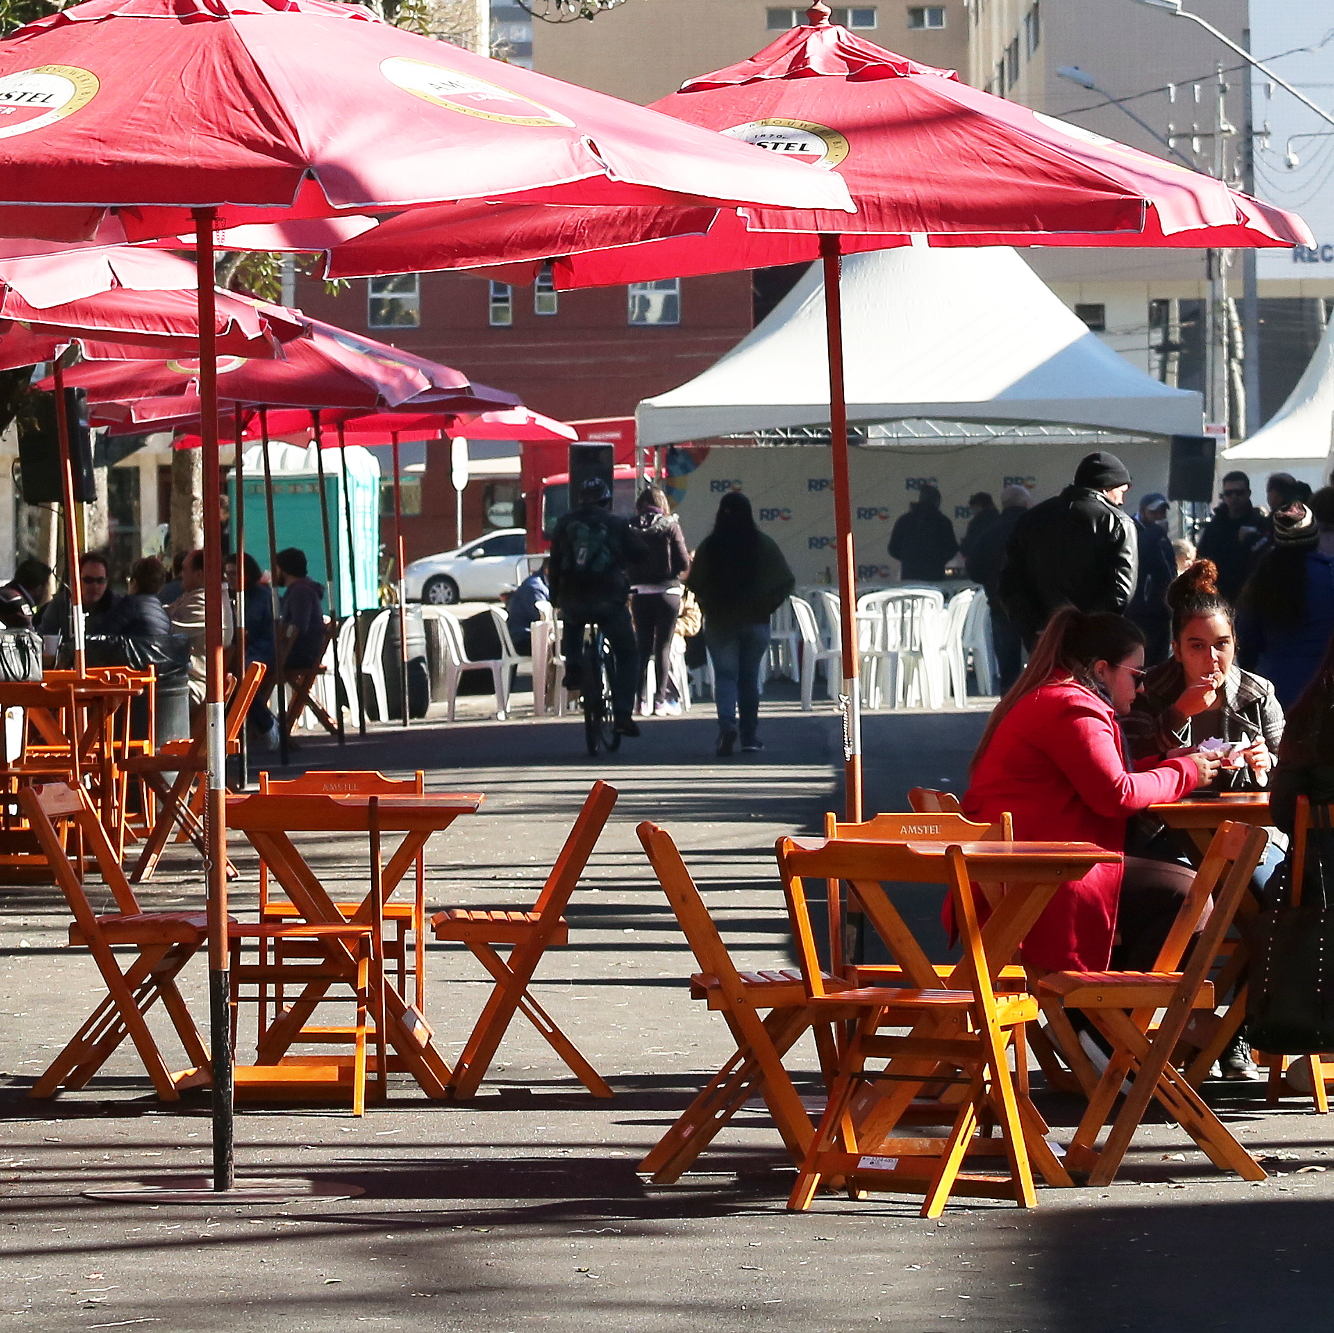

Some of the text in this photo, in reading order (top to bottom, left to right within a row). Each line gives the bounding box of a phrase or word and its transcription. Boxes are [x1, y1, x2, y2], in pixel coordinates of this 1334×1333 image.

[752, 141, 810, 152] STEL
[710, 479, 743, 493] RPC
[759, 507, 792, 521] RPC
[856, 507, 890, 521] RPC
[899, 824, 942, 835] AMSTEL
